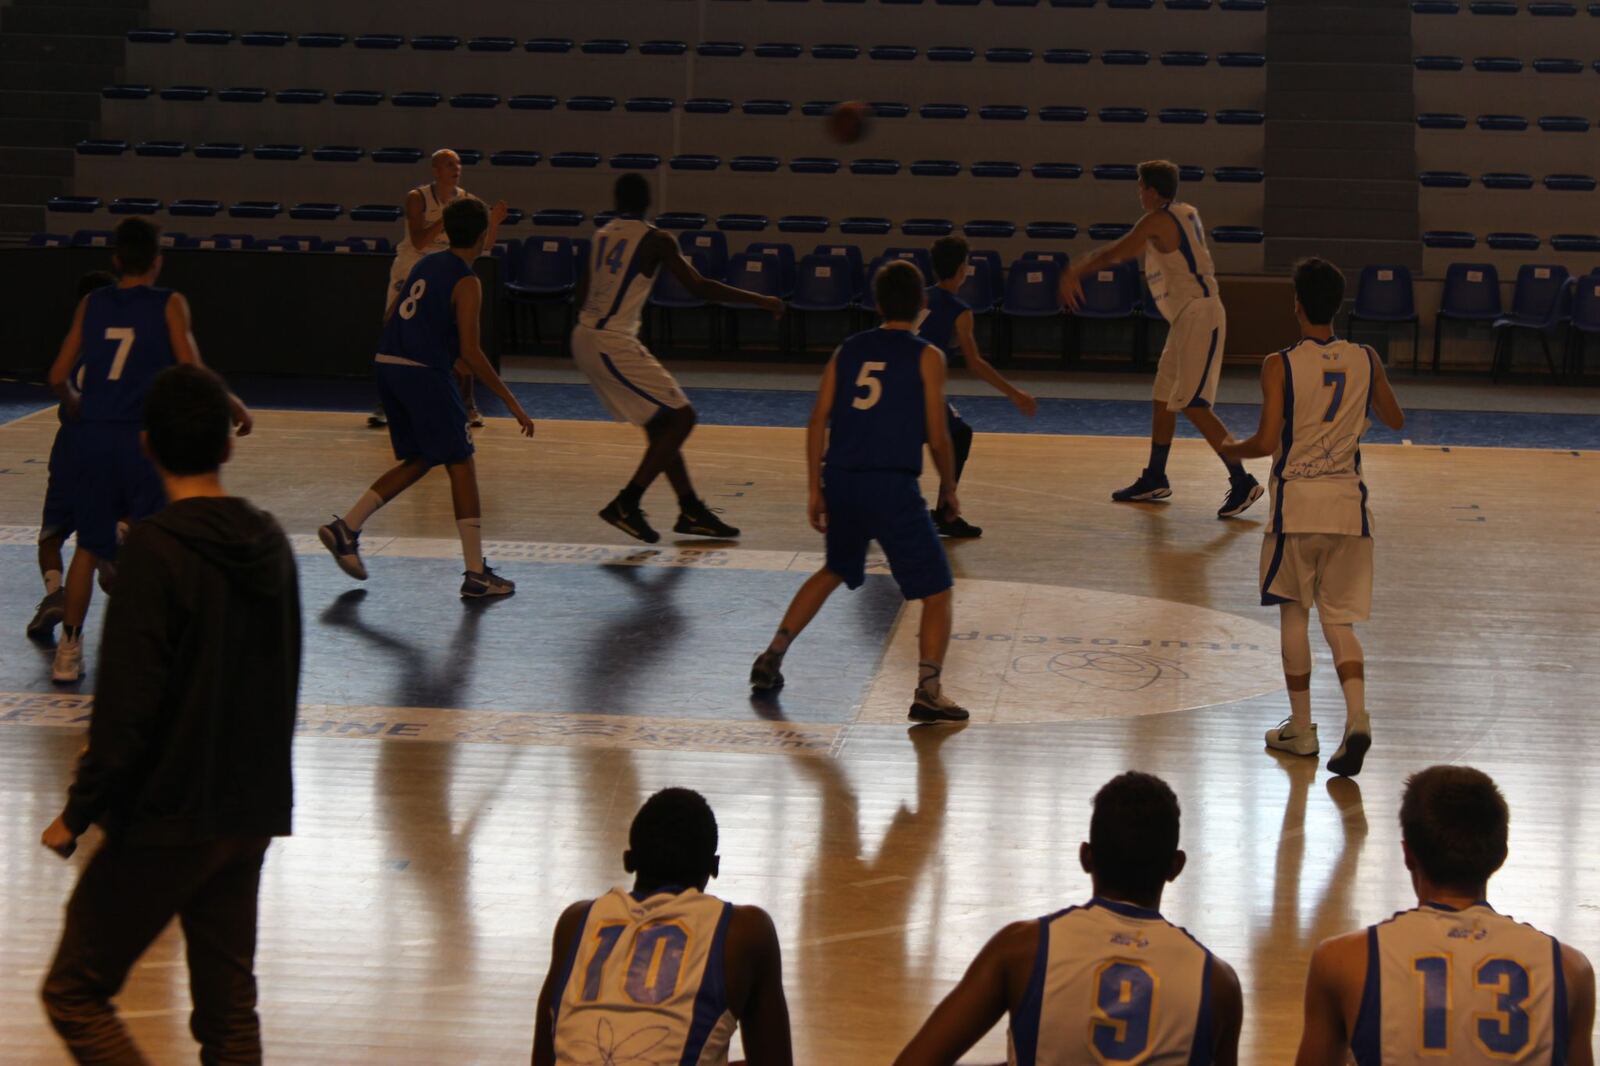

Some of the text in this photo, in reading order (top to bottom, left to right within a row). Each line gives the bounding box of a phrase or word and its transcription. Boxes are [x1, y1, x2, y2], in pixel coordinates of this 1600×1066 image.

[594, 235, 630, 275] 14
[399, 278, 427, 321] 8
[104, 326, 136, 382] 7
[850, 361, 888, 411] 5
[1323, 370, 1348, 423] 7
[915, 631, 1260, 651] uturoscop
[578, 917, 694, 1006] 10
[1088, 955, 1161, 1066] 9
[1408, 951, 1535, 1060] 13
